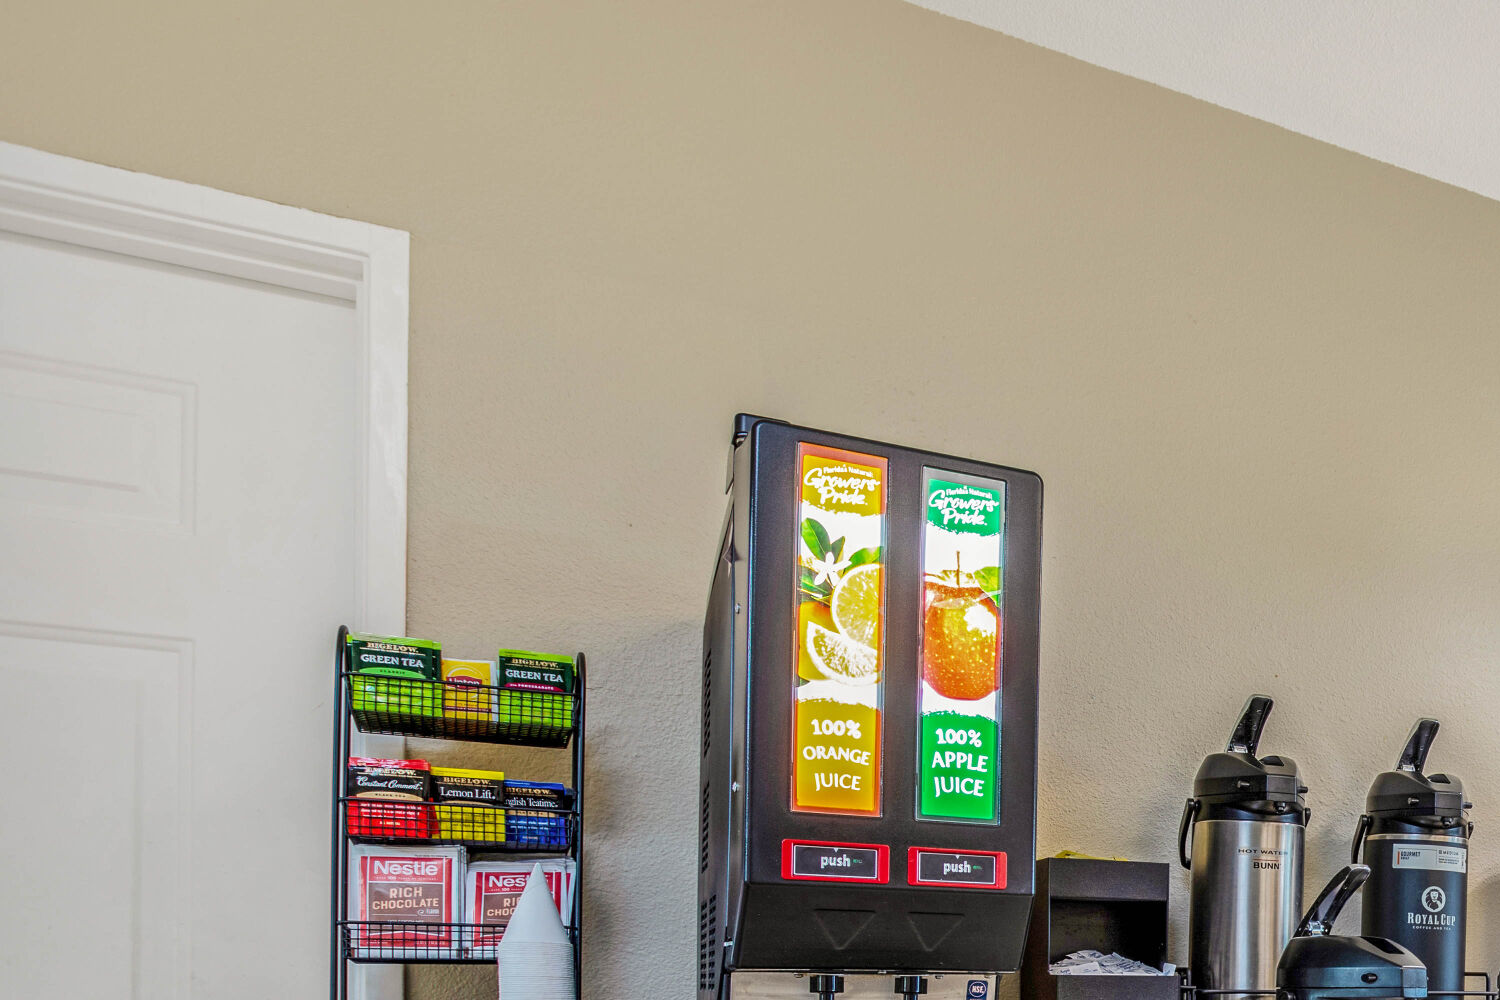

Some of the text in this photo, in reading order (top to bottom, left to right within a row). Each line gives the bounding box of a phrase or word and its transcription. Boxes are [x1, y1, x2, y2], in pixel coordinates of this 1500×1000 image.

[803, 467, 881, 491] Growers
[928, 489, 1000, 512] Growers
[360, 653, 425, 669] GREEN TEA
[505, 668, 565, 683] GREEN TEA
[810, 718, 862, 740] 100%
[935, 728, 983, 748] 100%
[802, 745, 872, 766] ORANGE
[931, 751, 989, 773] APPLE
[814, 772, 862, 792] JUICE
[933, 776, 985, 798] JUICE
[440, 786, 474, 799] Lemon
[503, 797, 527, 808] nglish
[820, 854, 851, 869] push
[943, 860, 972, 875] push
[1253, 861, 1280, 870] BUNN
[488, 874, 531, 888] Nes
[389, 886, 423, 899] RICH
[372, 898, 440, 911] CHOCOLATE
[503, 897, 521, 908] RI
[1407, 912, 1456, 926] ROYAL CUP
